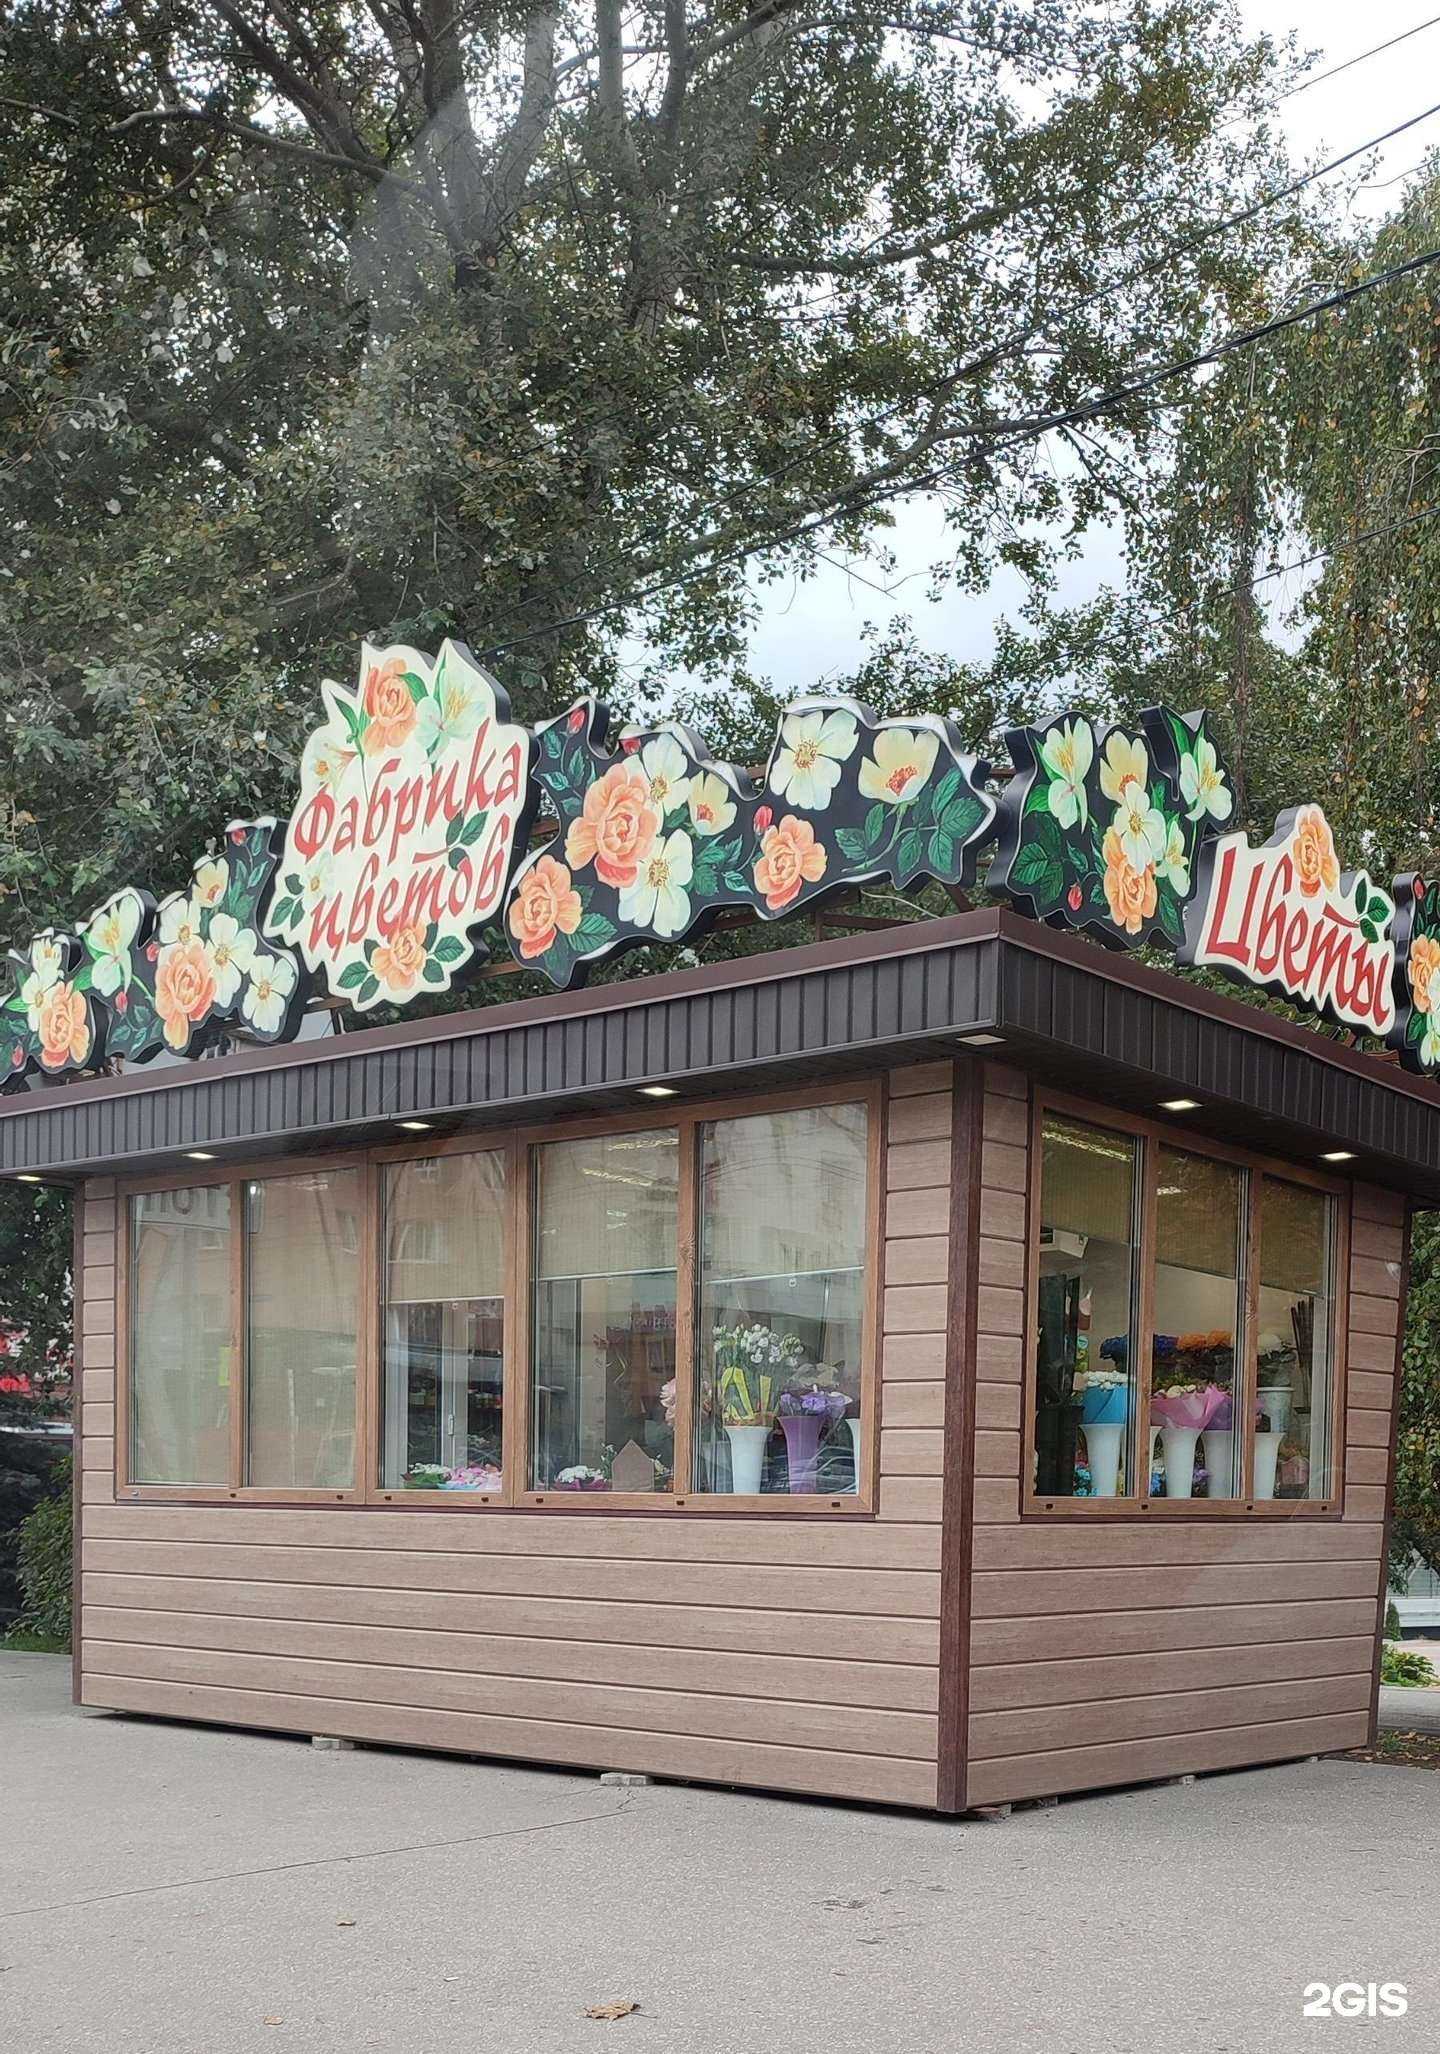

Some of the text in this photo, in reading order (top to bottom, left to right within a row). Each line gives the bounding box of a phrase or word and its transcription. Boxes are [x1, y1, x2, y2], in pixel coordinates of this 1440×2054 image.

[293, 716, 522, 865] Фабрика
[308, 813, 510, 961] цветов
[1205, 846, 1391, 1027] Цветы
